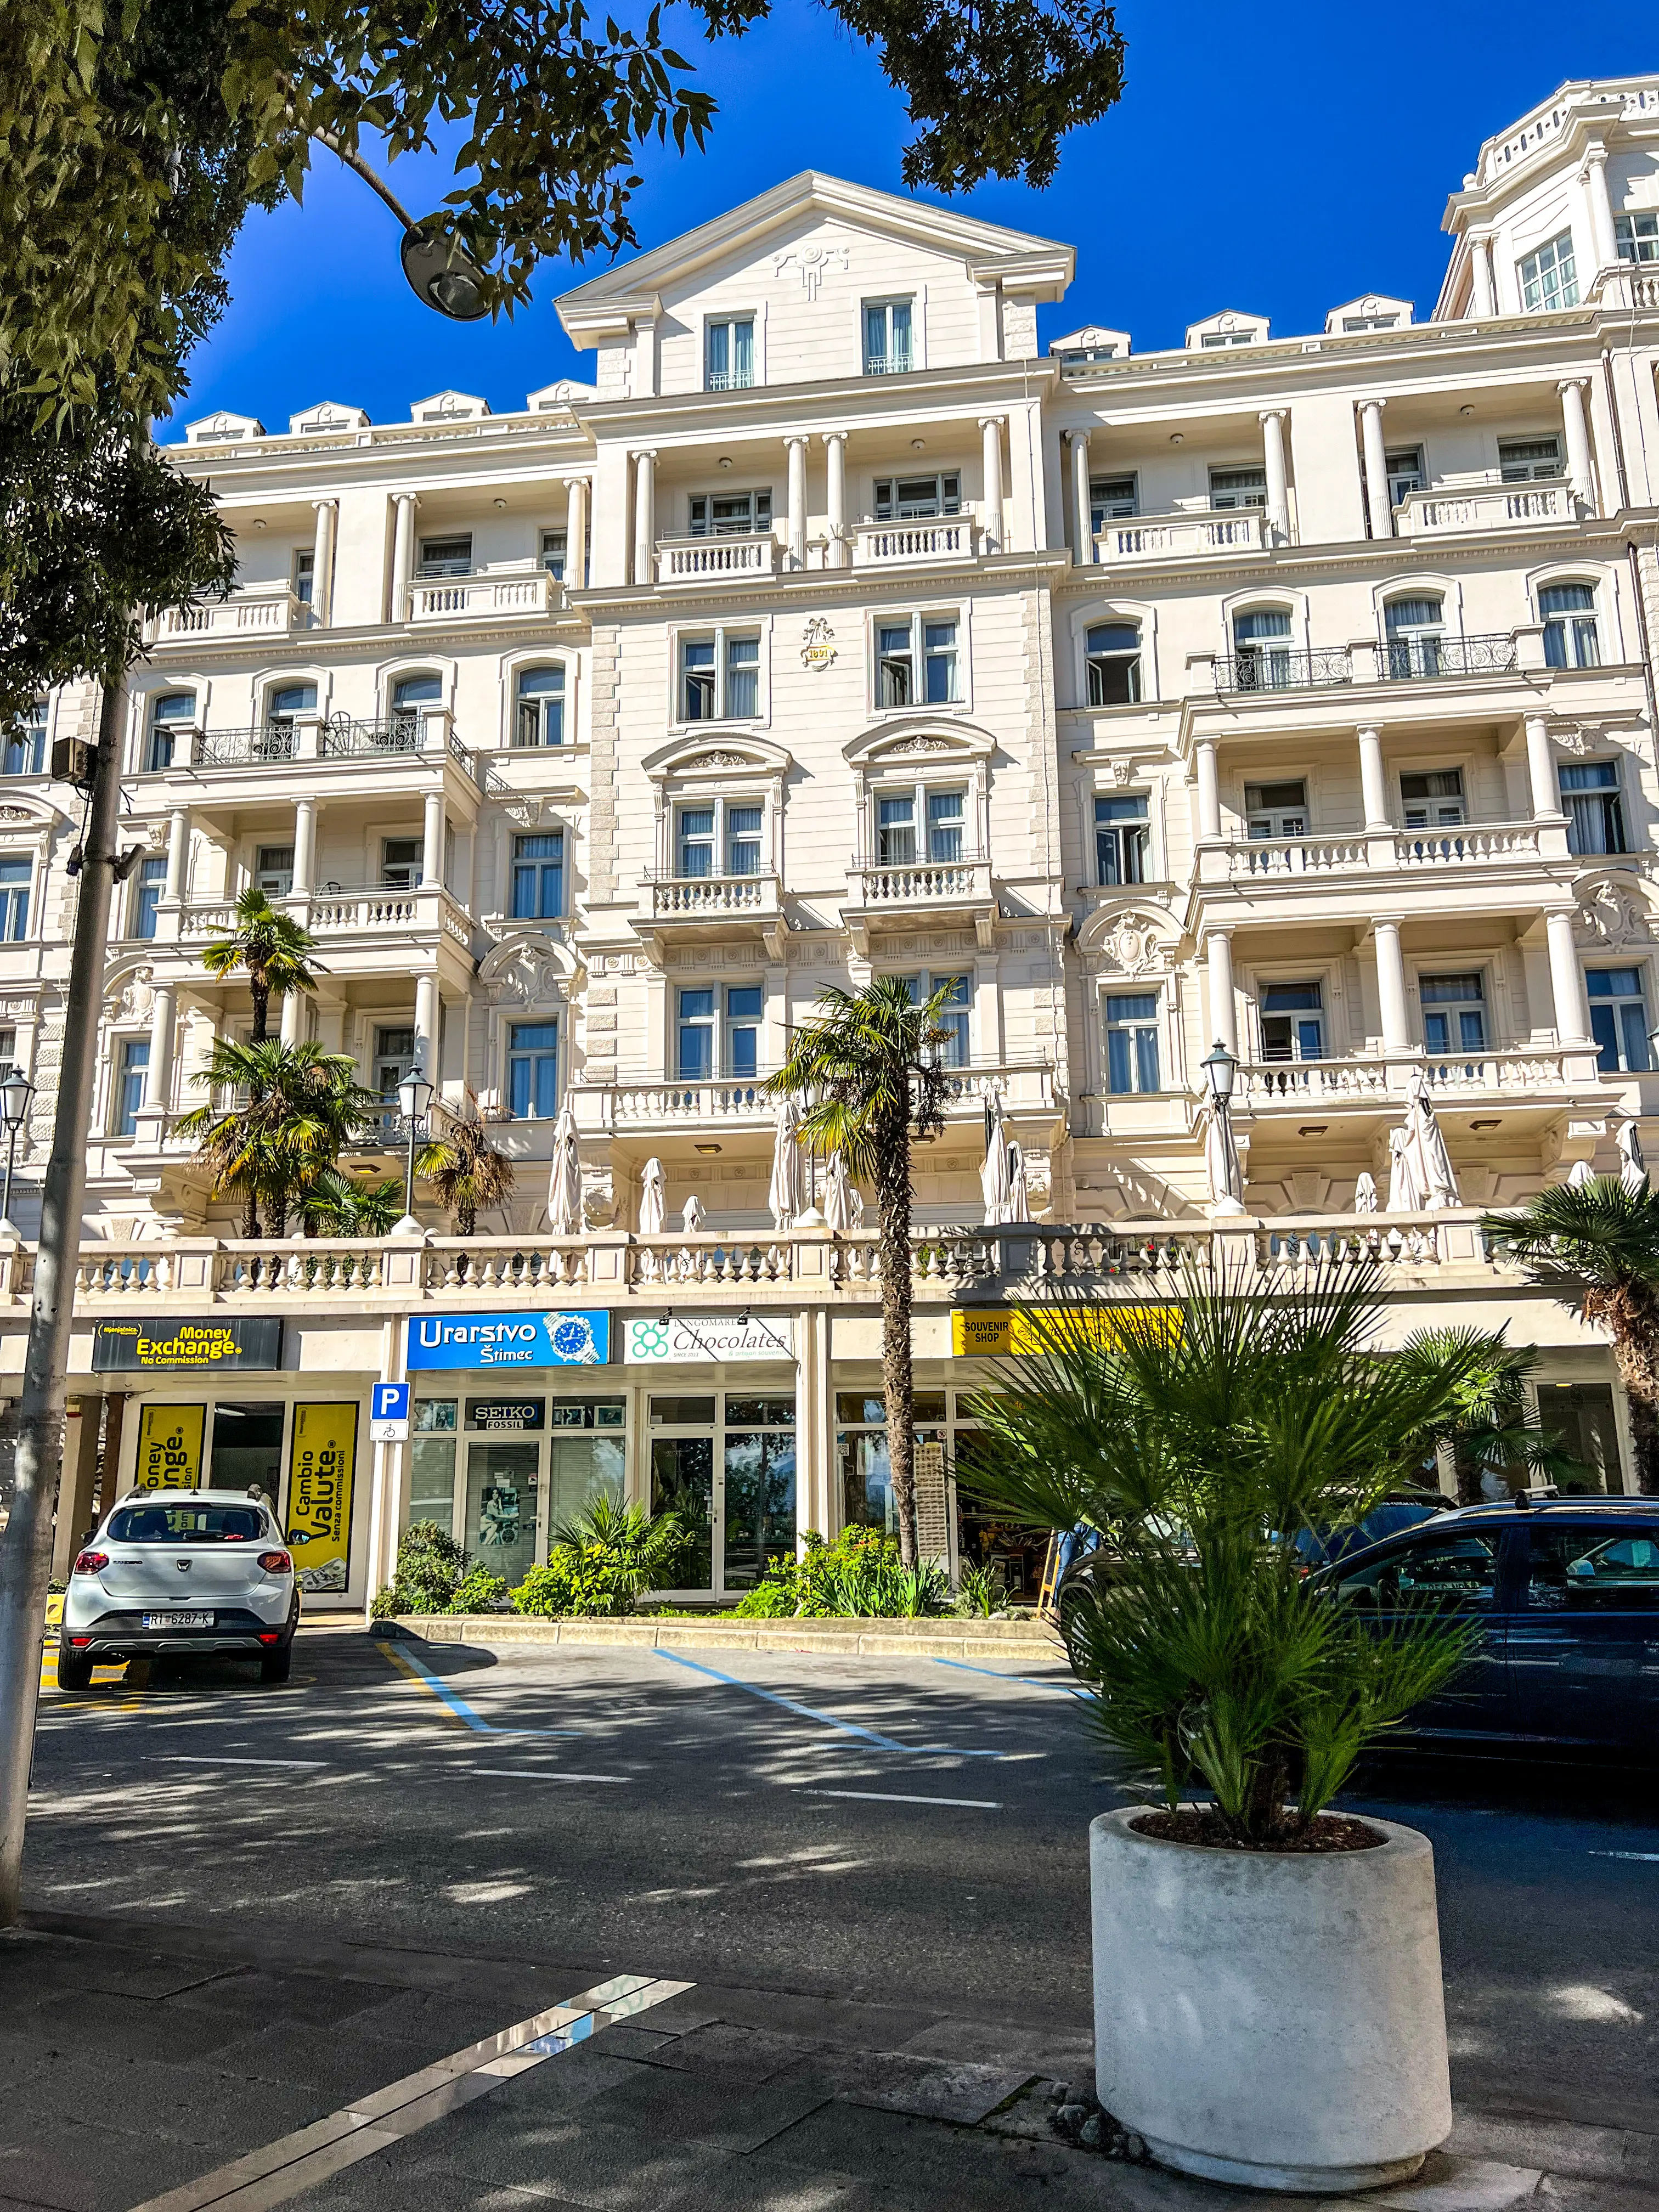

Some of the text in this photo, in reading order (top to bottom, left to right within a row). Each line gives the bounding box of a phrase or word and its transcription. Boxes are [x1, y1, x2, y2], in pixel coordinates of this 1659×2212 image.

[179, 1327, 232, 1341] Money
[420, 1321, 537, 1347] Urarstvo
[964, 1321, 1009, 1332] SOUVENIR
[975, 1332, 1000, 1342] SHOP
[137, 1337, 235, 1359] Exchange
[674, 1328, 787, 1350] Chocolates
[155, 1356, 209, 1364] Commission
[480, 1345, 533, 1363] Štimec
[381, 1389, 399, 1415] P
[475, 1406, 535, 1419] SEIKO
[146, 1442, 166, 1489] oney
[296, 1451, 313, 1516] Cambio
[311, 1451, 336, 1540] Valute
[332, 1450, 345, 1542] Senza commissioni
[151, 1613, 162, 1624] RI
